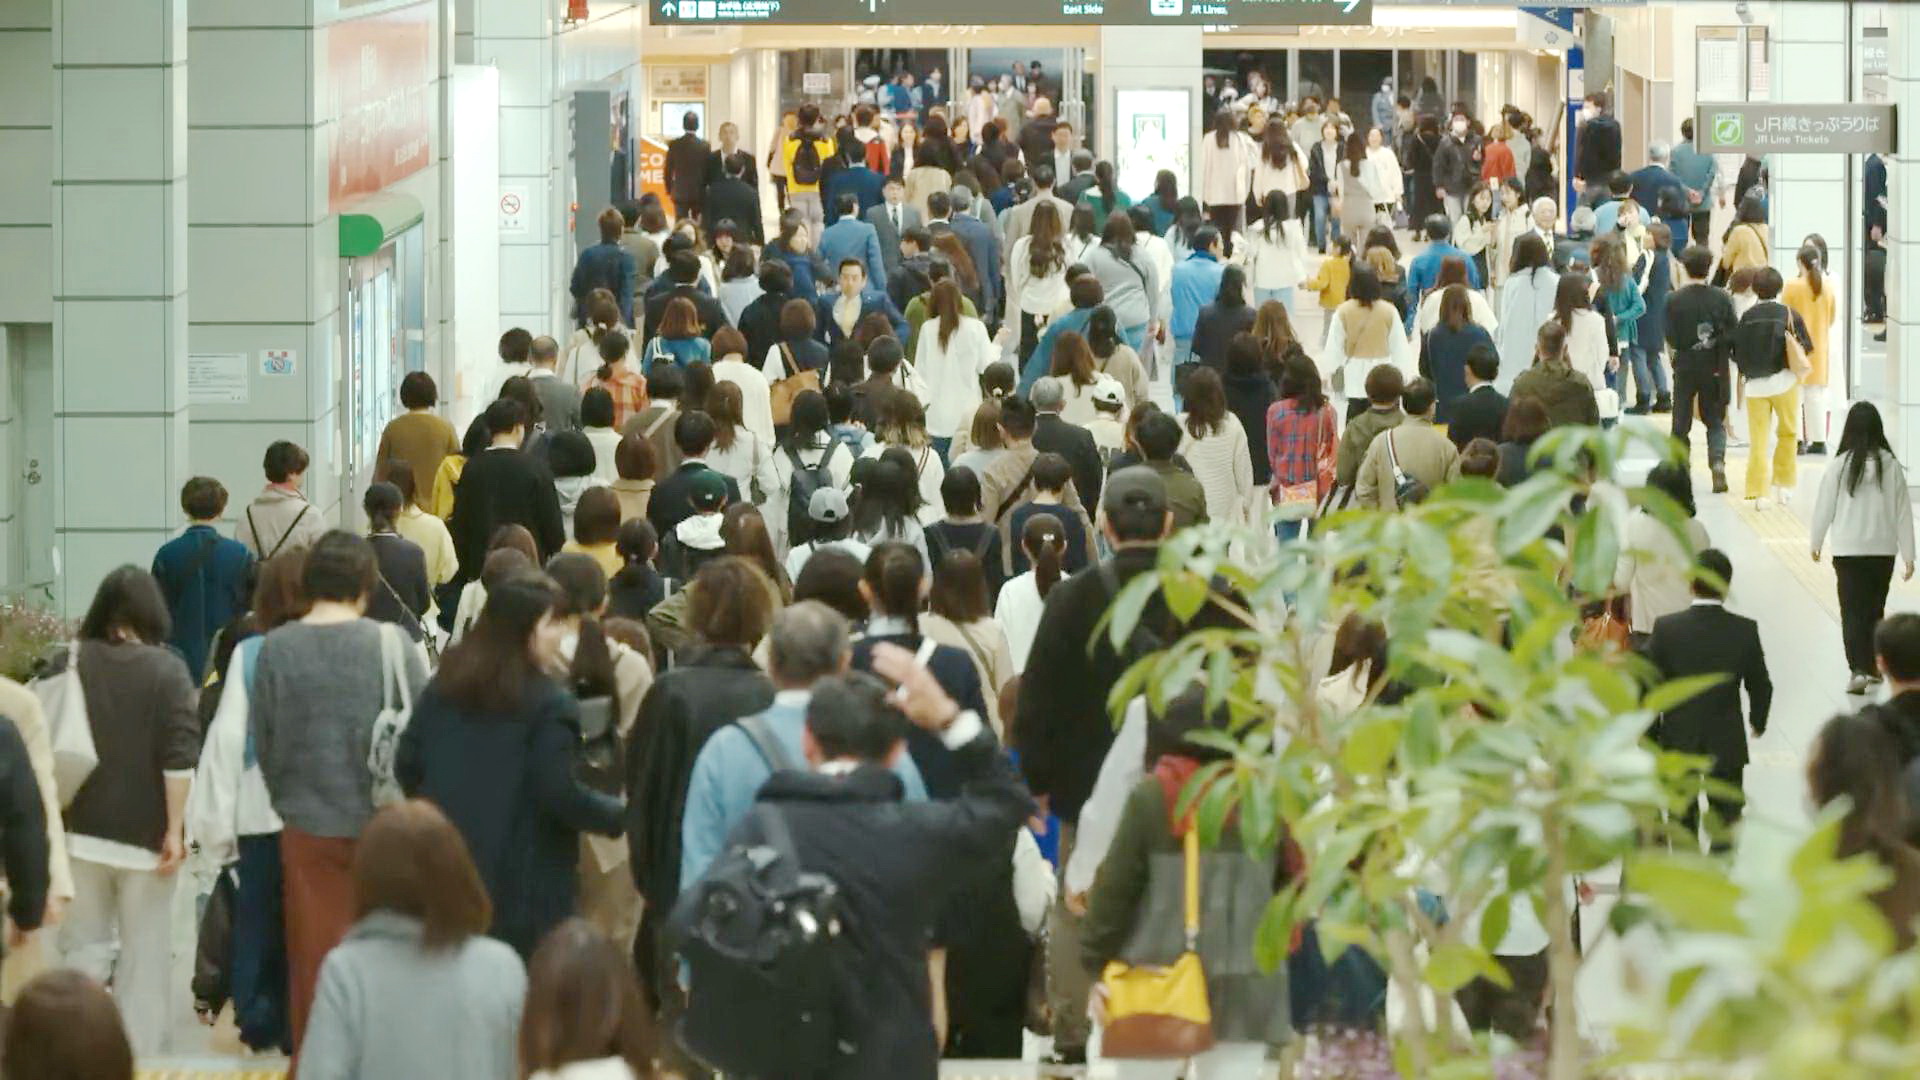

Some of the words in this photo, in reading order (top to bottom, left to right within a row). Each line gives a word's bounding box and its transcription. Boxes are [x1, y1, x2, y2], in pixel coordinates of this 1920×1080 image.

[1755, 135, 1768, 145] JR
[1770, 135, 1791, 145] Line
[1794, 135, 1830, 145] Tickets
